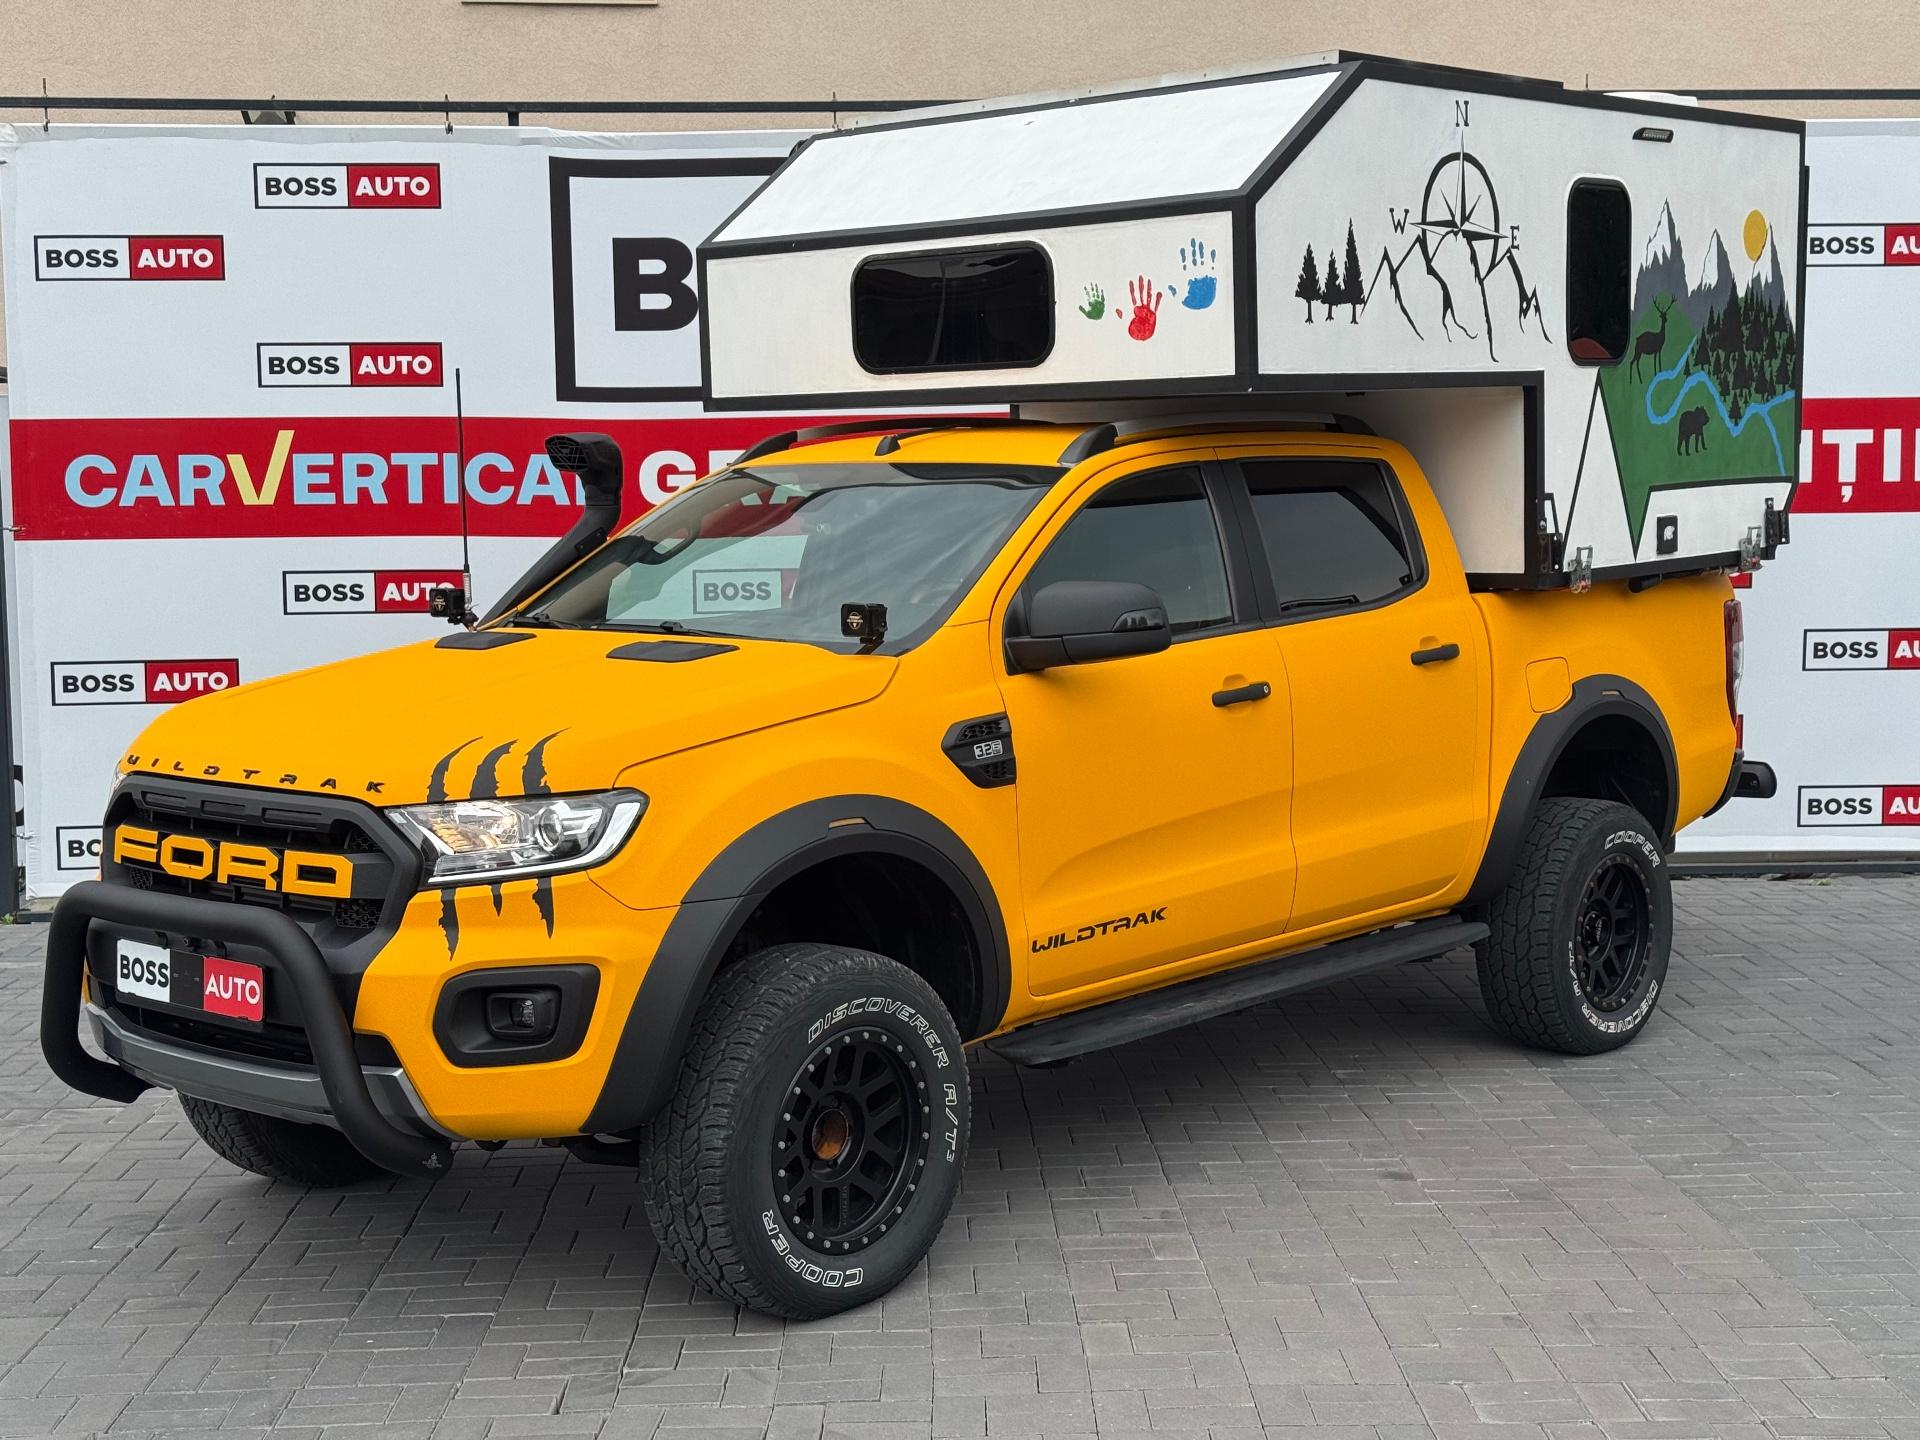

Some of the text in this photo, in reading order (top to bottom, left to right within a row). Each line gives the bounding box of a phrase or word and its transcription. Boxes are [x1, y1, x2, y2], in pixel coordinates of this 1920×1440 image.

[1455, 100, 1469, 127] N
[265, 176, 431, 197] BOSS AUTO
[1389, 208, 1409, 235] W
[1510, 225, 1519, 250] E
[1809, 236, 1875, 254] BOSS
[45, 248, 214, 269] BOSS AUTO
[268, 355, 433, 375] BOSS AUTO
[64, 429, 586, 507] CARVERTICA
[293, 583, 365, 602] BOSS
[703, 580, 772, 601] BOSS
[1813, 641, 1879, 659] BOSS
[62, 671, 229, 693] BOSS AUTO
[127, 754, 385, 793] WILDTRAK
[1807, 797, 1873, 815] BOSS
[113, 824, 354, 899] FORD
[1604, 830, 1661, 868] COOPER
[1031, 906, 1168, 953] WILDTRAK
[120, 954, 261, 1005] BOSS AUTO
[1582, 979, 1659, 1033] DISCOVERER
[808, 997, 950, 1069] DISCOVERER
[762, 1209, 864, 1288] COOPER
